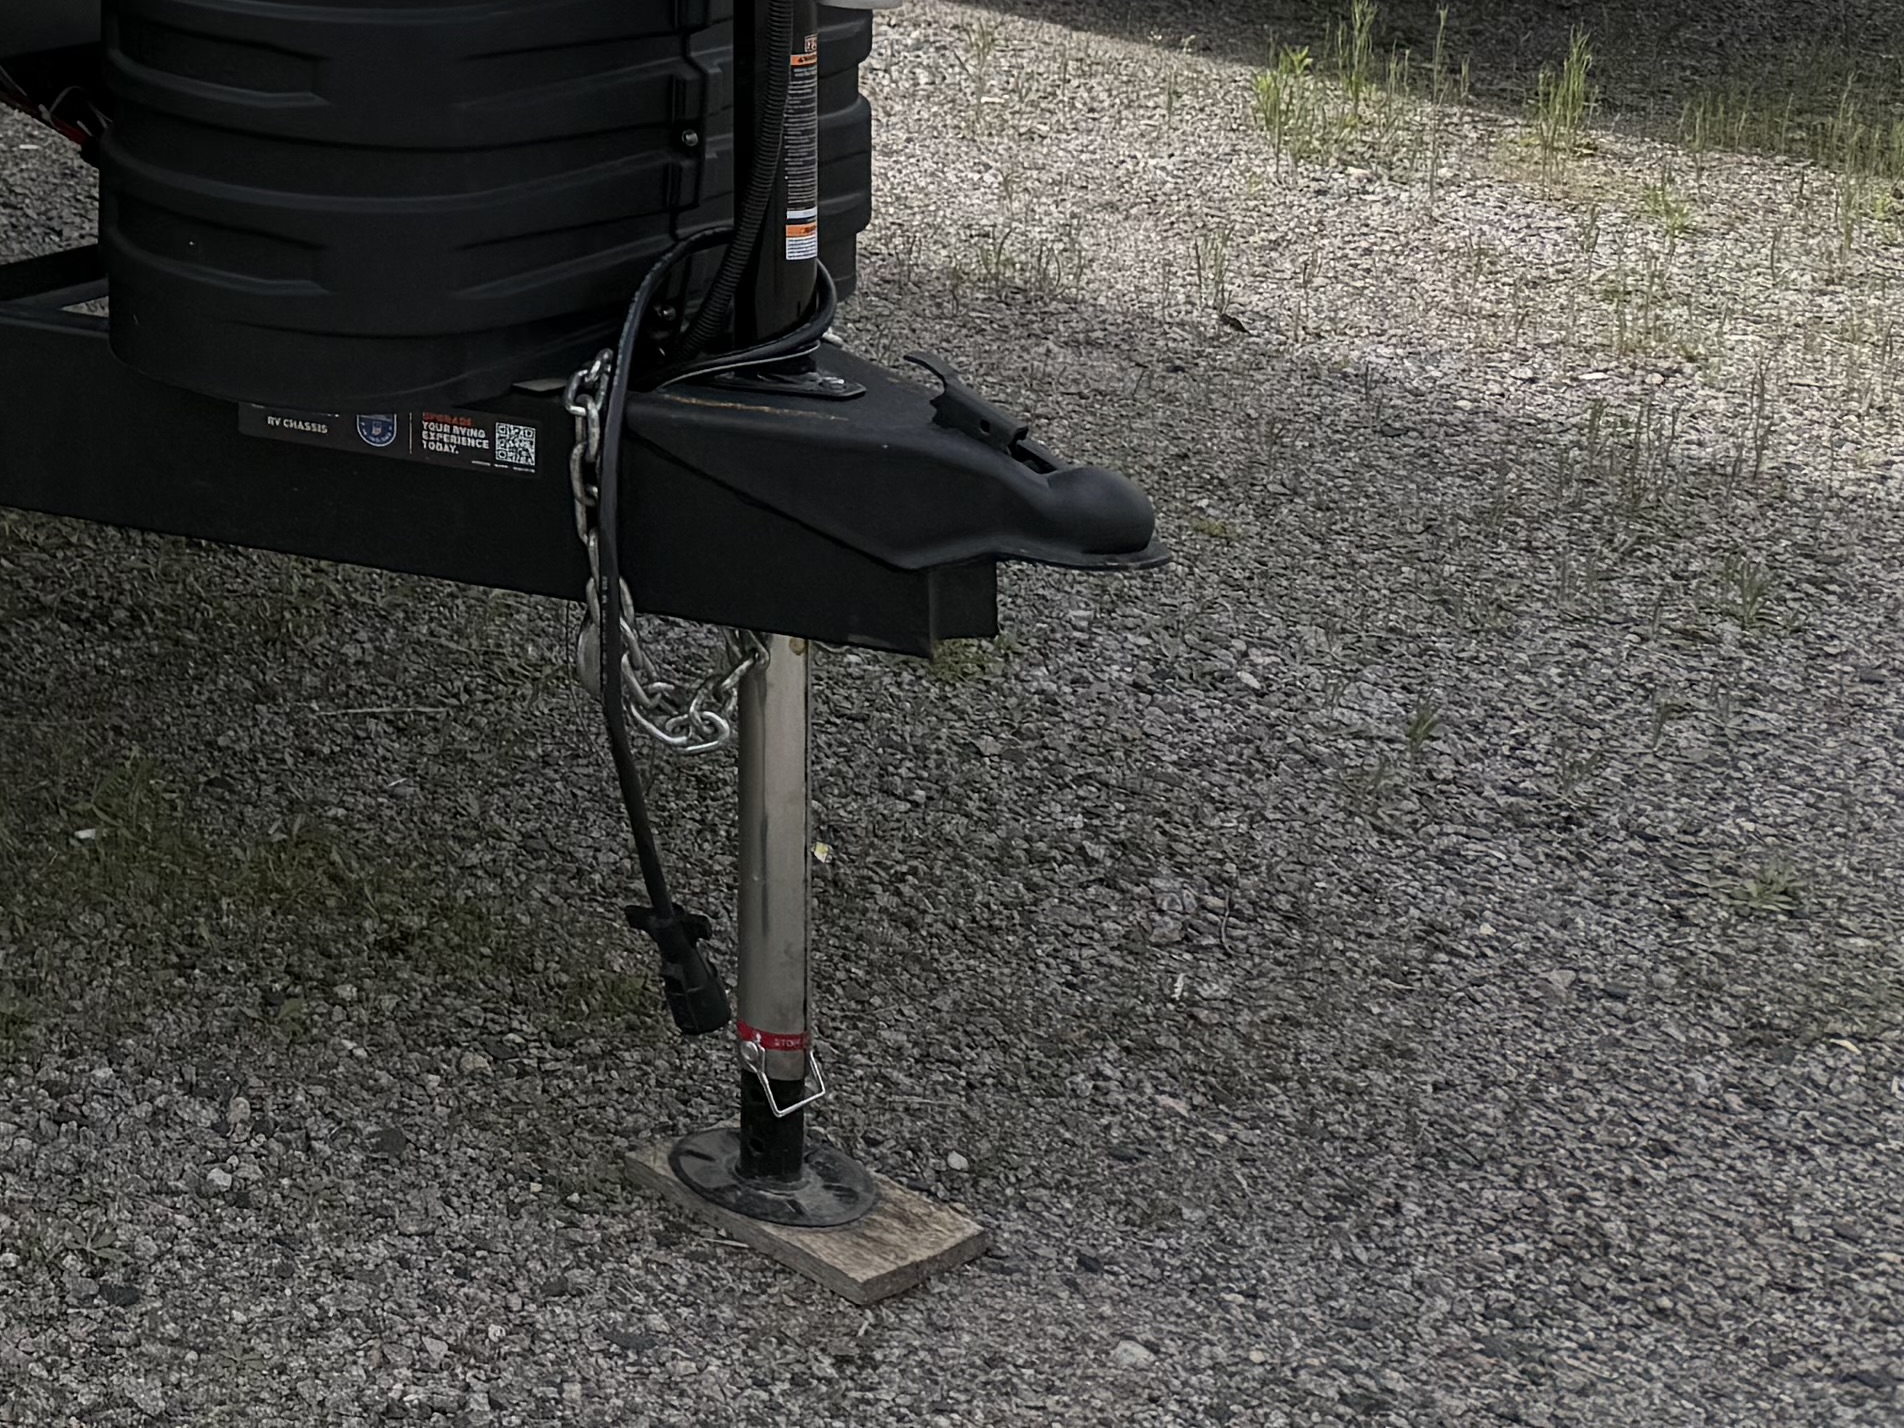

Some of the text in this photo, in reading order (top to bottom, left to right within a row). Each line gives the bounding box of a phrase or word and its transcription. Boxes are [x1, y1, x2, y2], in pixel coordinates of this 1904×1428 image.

[266, 415, 329, 435] RV CHASSIS
[421, 420, 486, 439] YOUR RVING
[421, 429, 490, 450] EXPERIENCE
[421, 439, 460, 455] TODAY.
